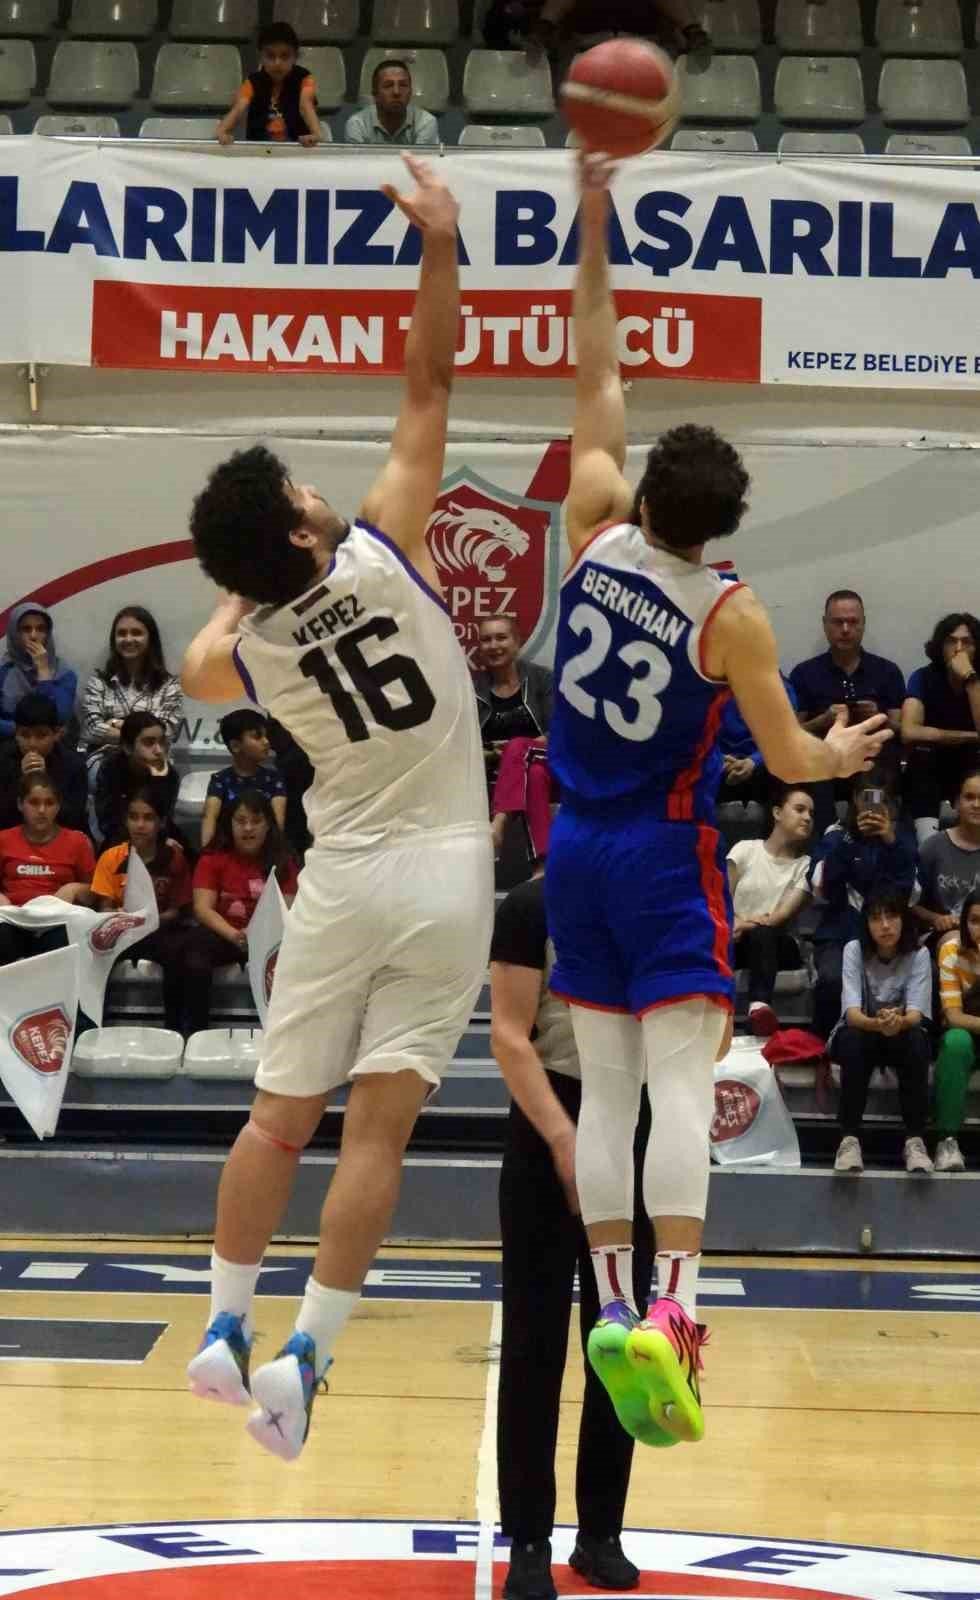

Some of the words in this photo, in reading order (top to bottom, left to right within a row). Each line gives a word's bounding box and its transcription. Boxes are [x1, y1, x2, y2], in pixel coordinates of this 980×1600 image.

[160, 310, 384, 364] HAKAN
[399, 304, 695, 368] ÜTÜCÜ
[787, 350, 857, 370] KEPEZ
[291, 593, 367, 647] KEPEZ
[298, 615, 436, 743] 16
[558, 602, 673, 742] 23
[29, 1026, 51, 1063] KEPEZ
